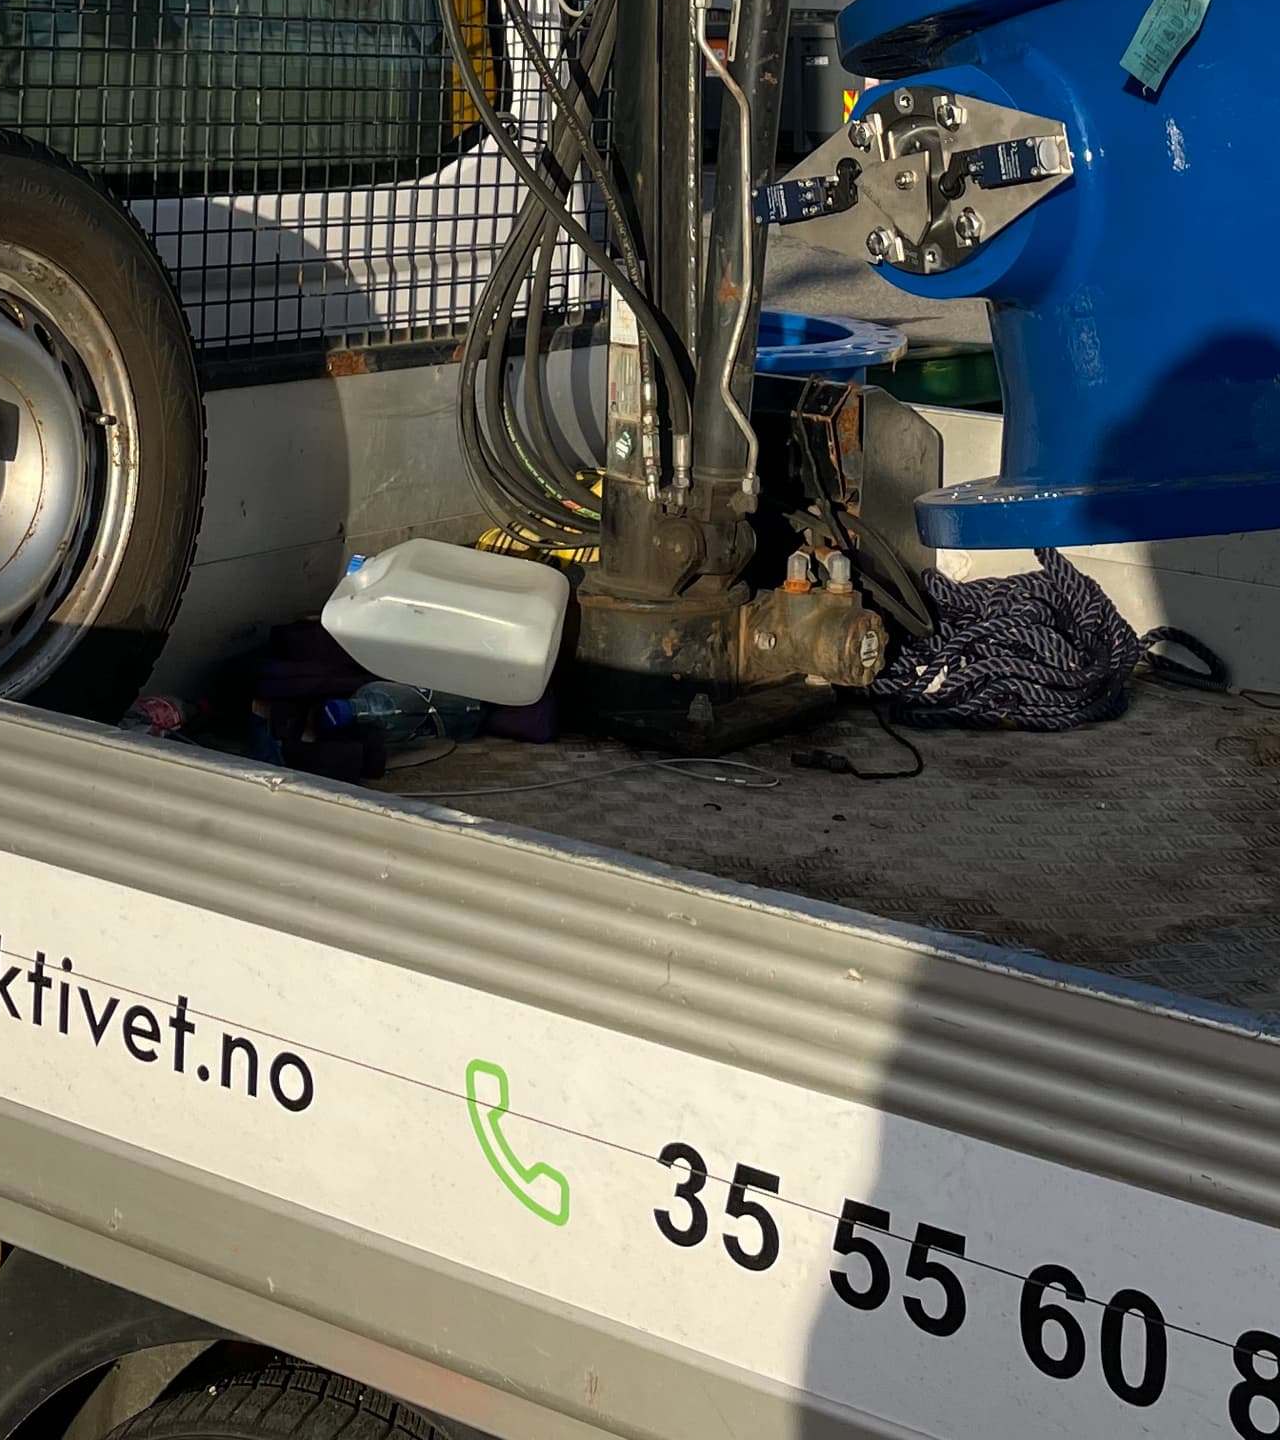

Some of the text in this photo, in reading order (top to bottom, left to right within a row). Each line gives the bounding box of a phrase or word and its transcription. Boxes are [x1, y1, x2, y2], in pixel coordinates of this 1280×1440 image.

[652, 1142, 782, 1273] 35
[829, 1199, 969, 1338] 55
[1017, 1263, 1169, 1408] 60
